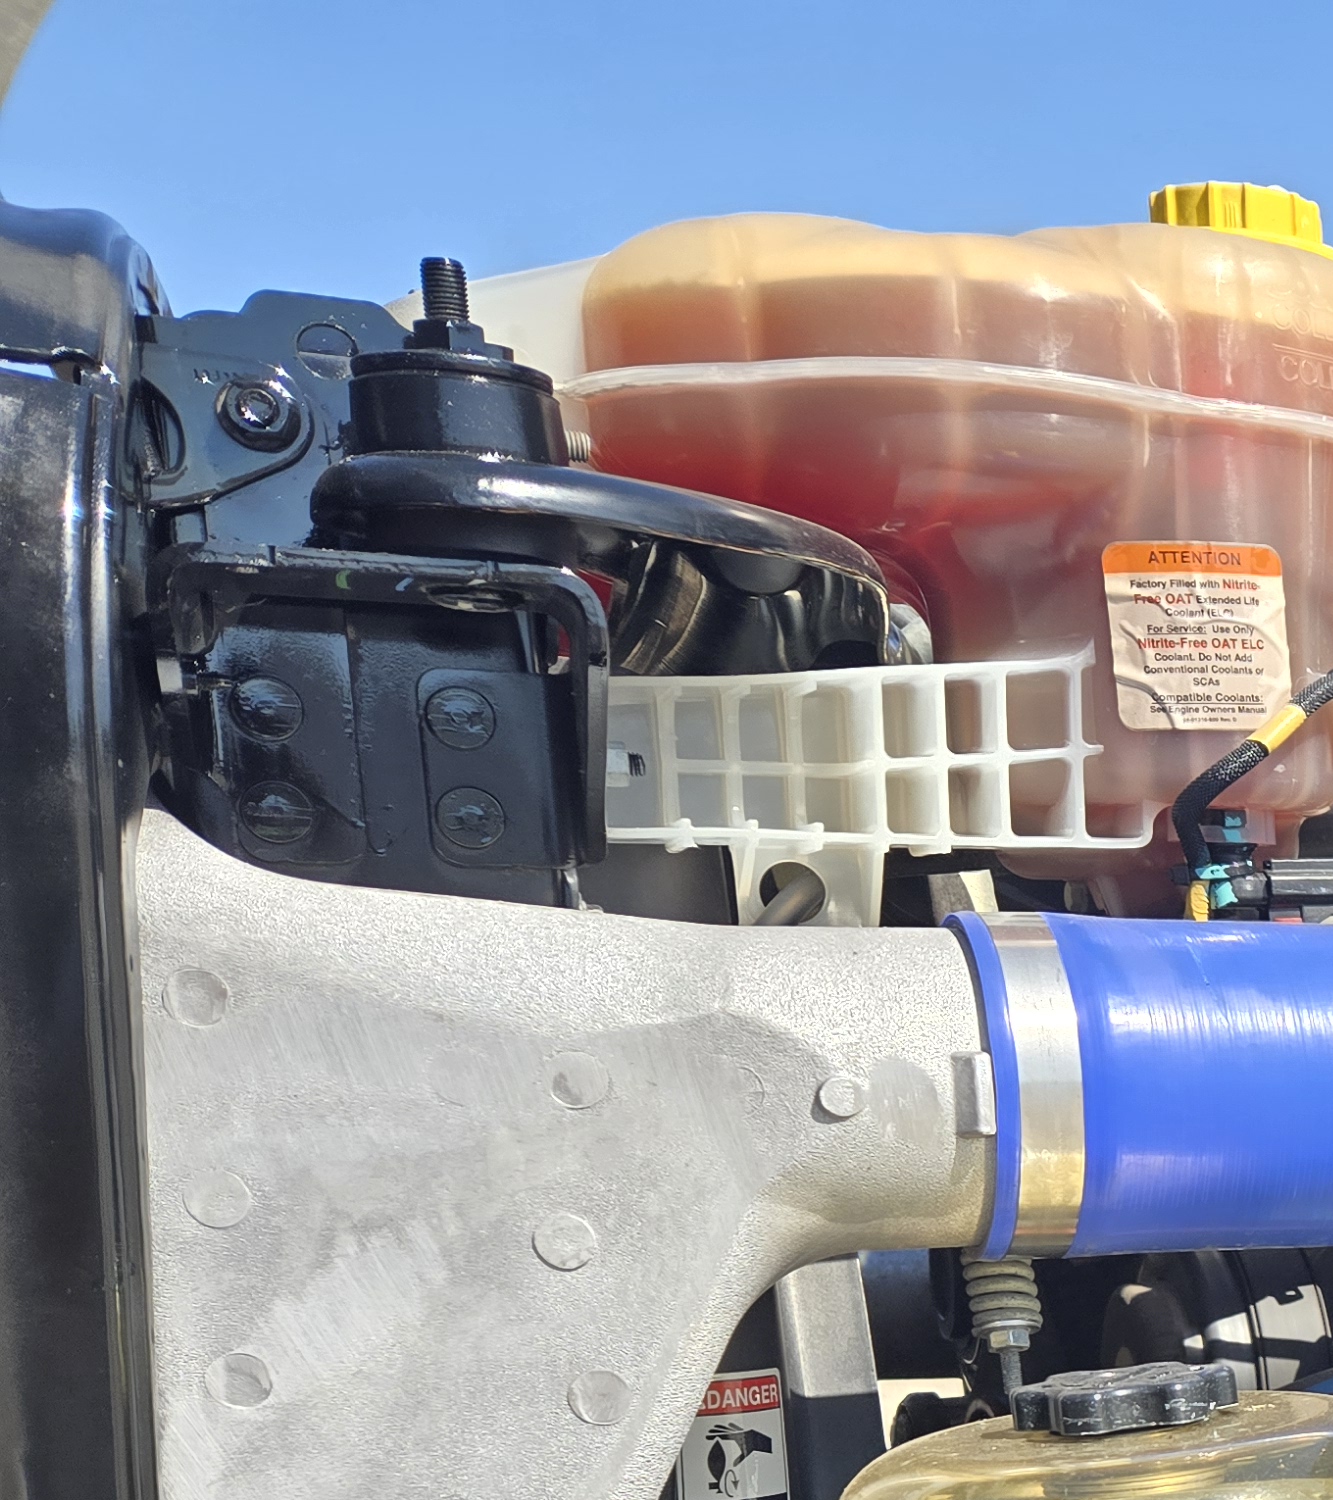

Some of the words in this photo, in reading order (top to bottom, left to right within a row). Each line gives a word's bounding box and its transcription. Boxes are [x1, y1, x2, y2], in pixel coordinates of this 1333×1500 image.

[1148, 550, 1241, 566] ATTENTION
[1130, 578, 1167, 590] Factory
[1170, 578, 1197, 589] Filled
[1199, 579, 1220, 589] with
[1223, 579, 1261, 591] Nitrite-
[1134, 593, 1161, 604] Free
[1165, 593, 1194, 605] OAT
[1196, 595, 1241, 605] Extended
[1244, 595, 1260, 606] Life
[1165, 608, 1205, 618] Coolant
[1147, 624, 1164, 634] For
[1166, 624, 1207, 635] Service:
[1212, 625, 1230, 635] Use
[1233, 625, 1255, 637] Only
[1138, 638, 1208, 649] Nitrite-Free
[1212, 638, 1239, 649] OAT
[1241, 638, 1265, 650] ELC
[1154, 652, 1196, 662] Coolant.
[1199, 652, 1213, 662] Do
[1215, 653, 1232, 662] Not
[1234, 653, 1253, 663] Add
[1143, 665, 1209, 675] Conventional
[1211, 665, 1252, 676] Coolants
[1255, 666, 1264, 676] or
[1193, 677, 1220, 687] SCAs
[1151, 692, 1212, 704] Compatible
[1215, 693, 1264, 703] Coolants:
[1169, 705, 1200, 716] Engine
[1202, 705, 1236, 714] Owners
[1238, 705, 1268, 714] Manual
[706, 1383, 779, 1410] DANGER
